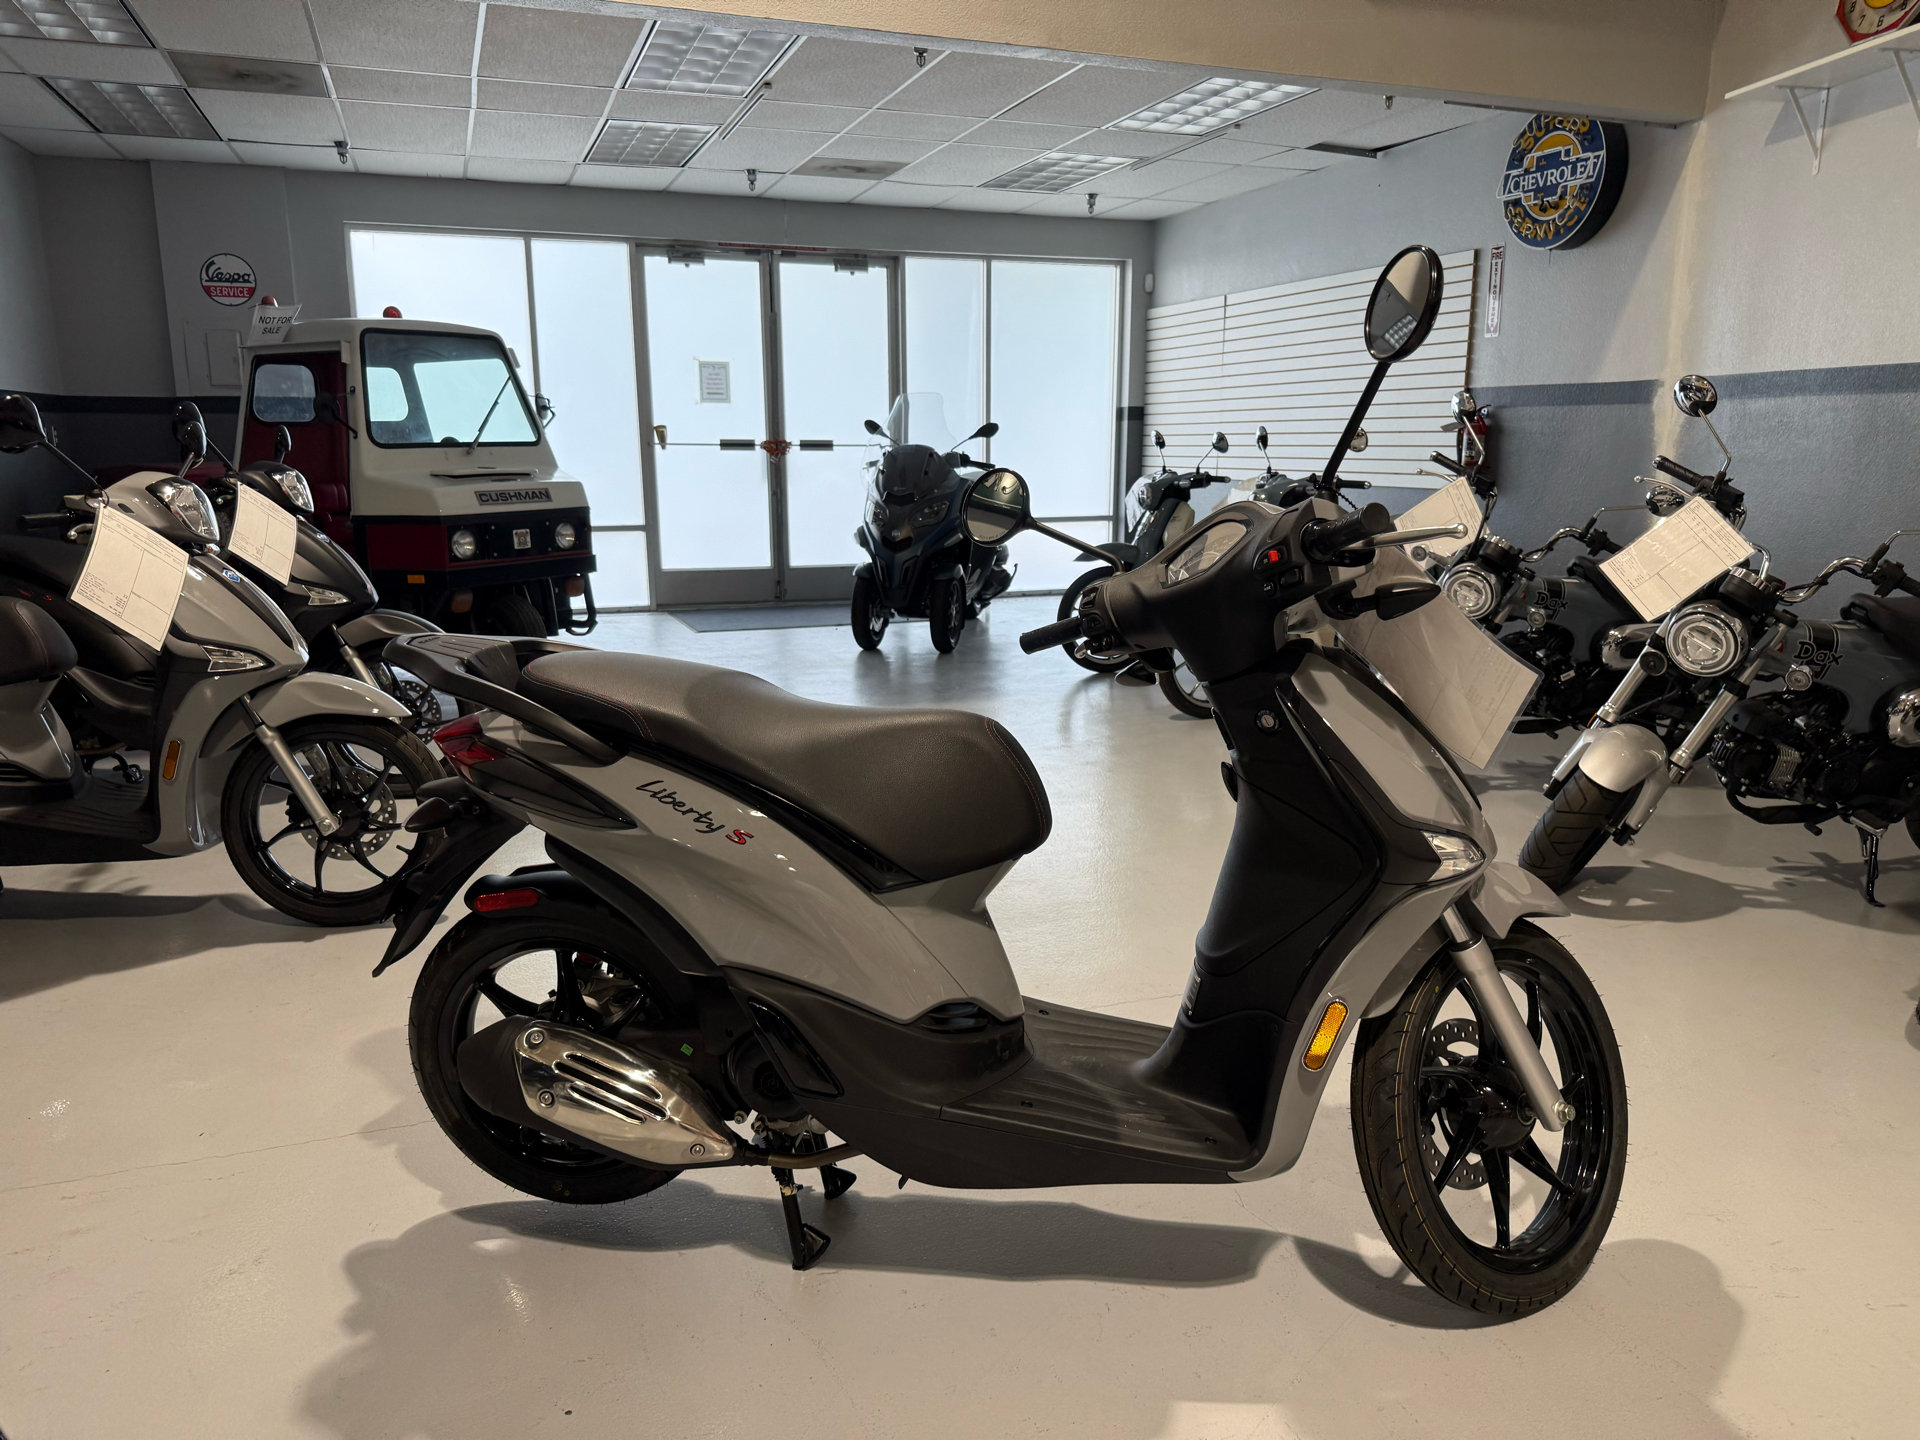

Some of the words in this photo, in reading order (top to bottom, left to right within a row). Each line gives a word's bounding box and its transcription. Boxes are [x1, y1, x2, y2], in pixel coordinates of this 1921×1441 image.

[1850, 1, 1857, 13] 8
[1858, 14, 1867, 27] 7
[1877, 15, 1885, 28] 6
[1510, 160, 1597, 191] CHEVROLET
[1492, 251, 1503, 260] FIRE
[205, 260, 253, 284] Vespa
[210, 286, 250, 297] SERVICE
[259, 315, 276, 324] NOT
[276, 316, 292, 324] FOR
[262, 326, 281, 334] SALE
[479, 490, 550, 503] CUSHMAN
[1533, 591, 1569, 610] Dax
[1793, 640, 1843, 665] Dax
[636, 780, 726, 834] Liberty
[725, 829, 755, 845] S
